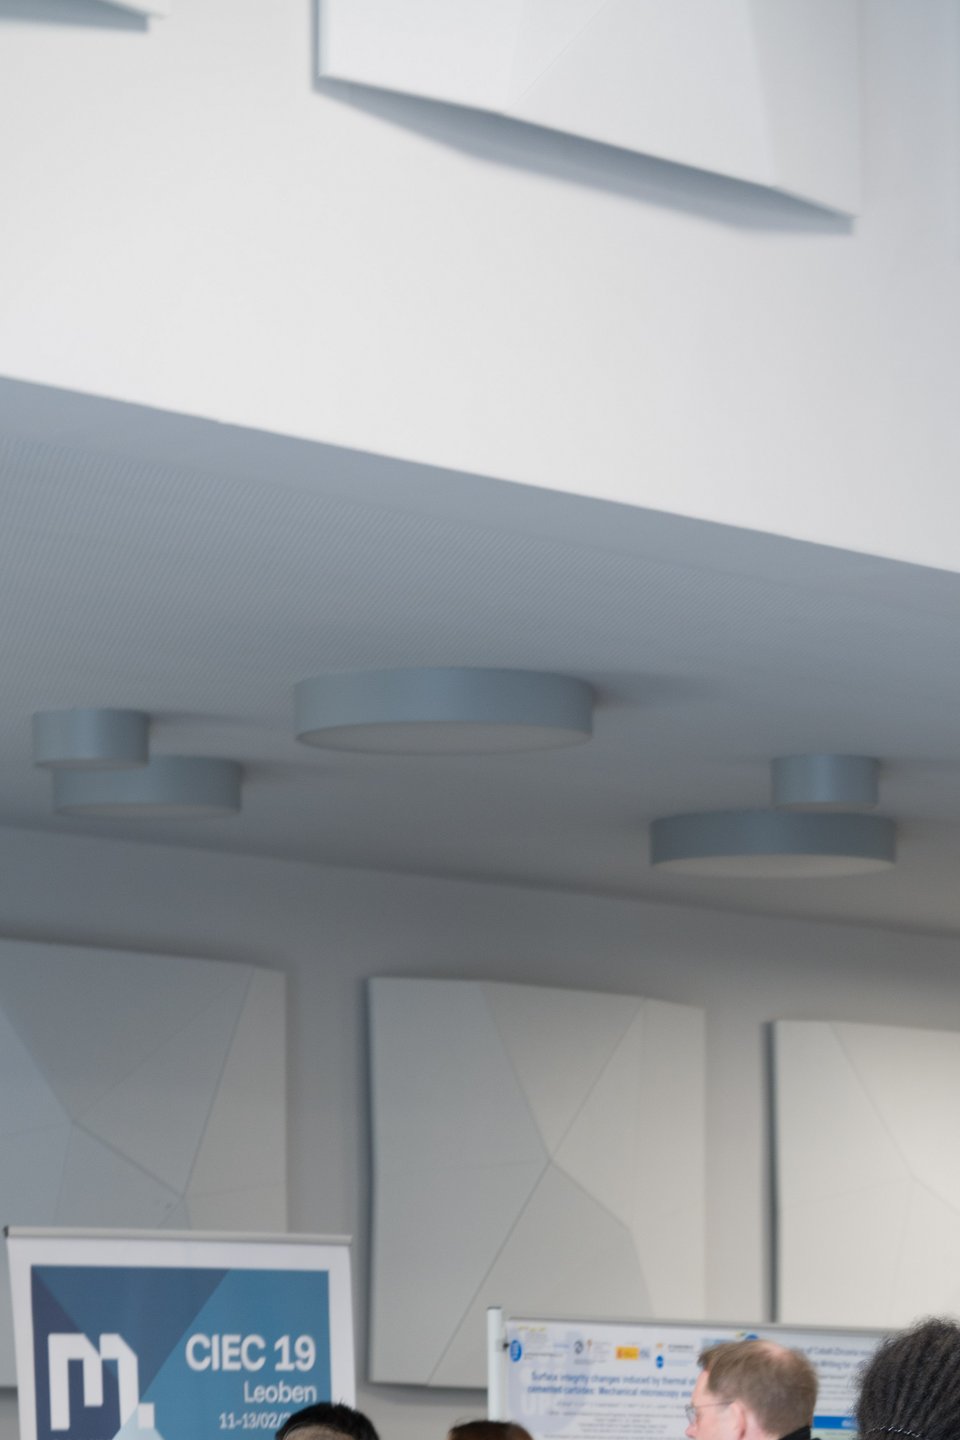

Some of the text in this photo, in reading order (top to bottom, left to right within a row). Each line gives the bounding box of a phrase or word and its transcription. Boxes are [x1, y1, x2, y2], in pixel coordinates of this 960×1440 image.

[185, 1333, 316, 1372] CIEC 19
[243, 1380, 318, 1404] Leoben
